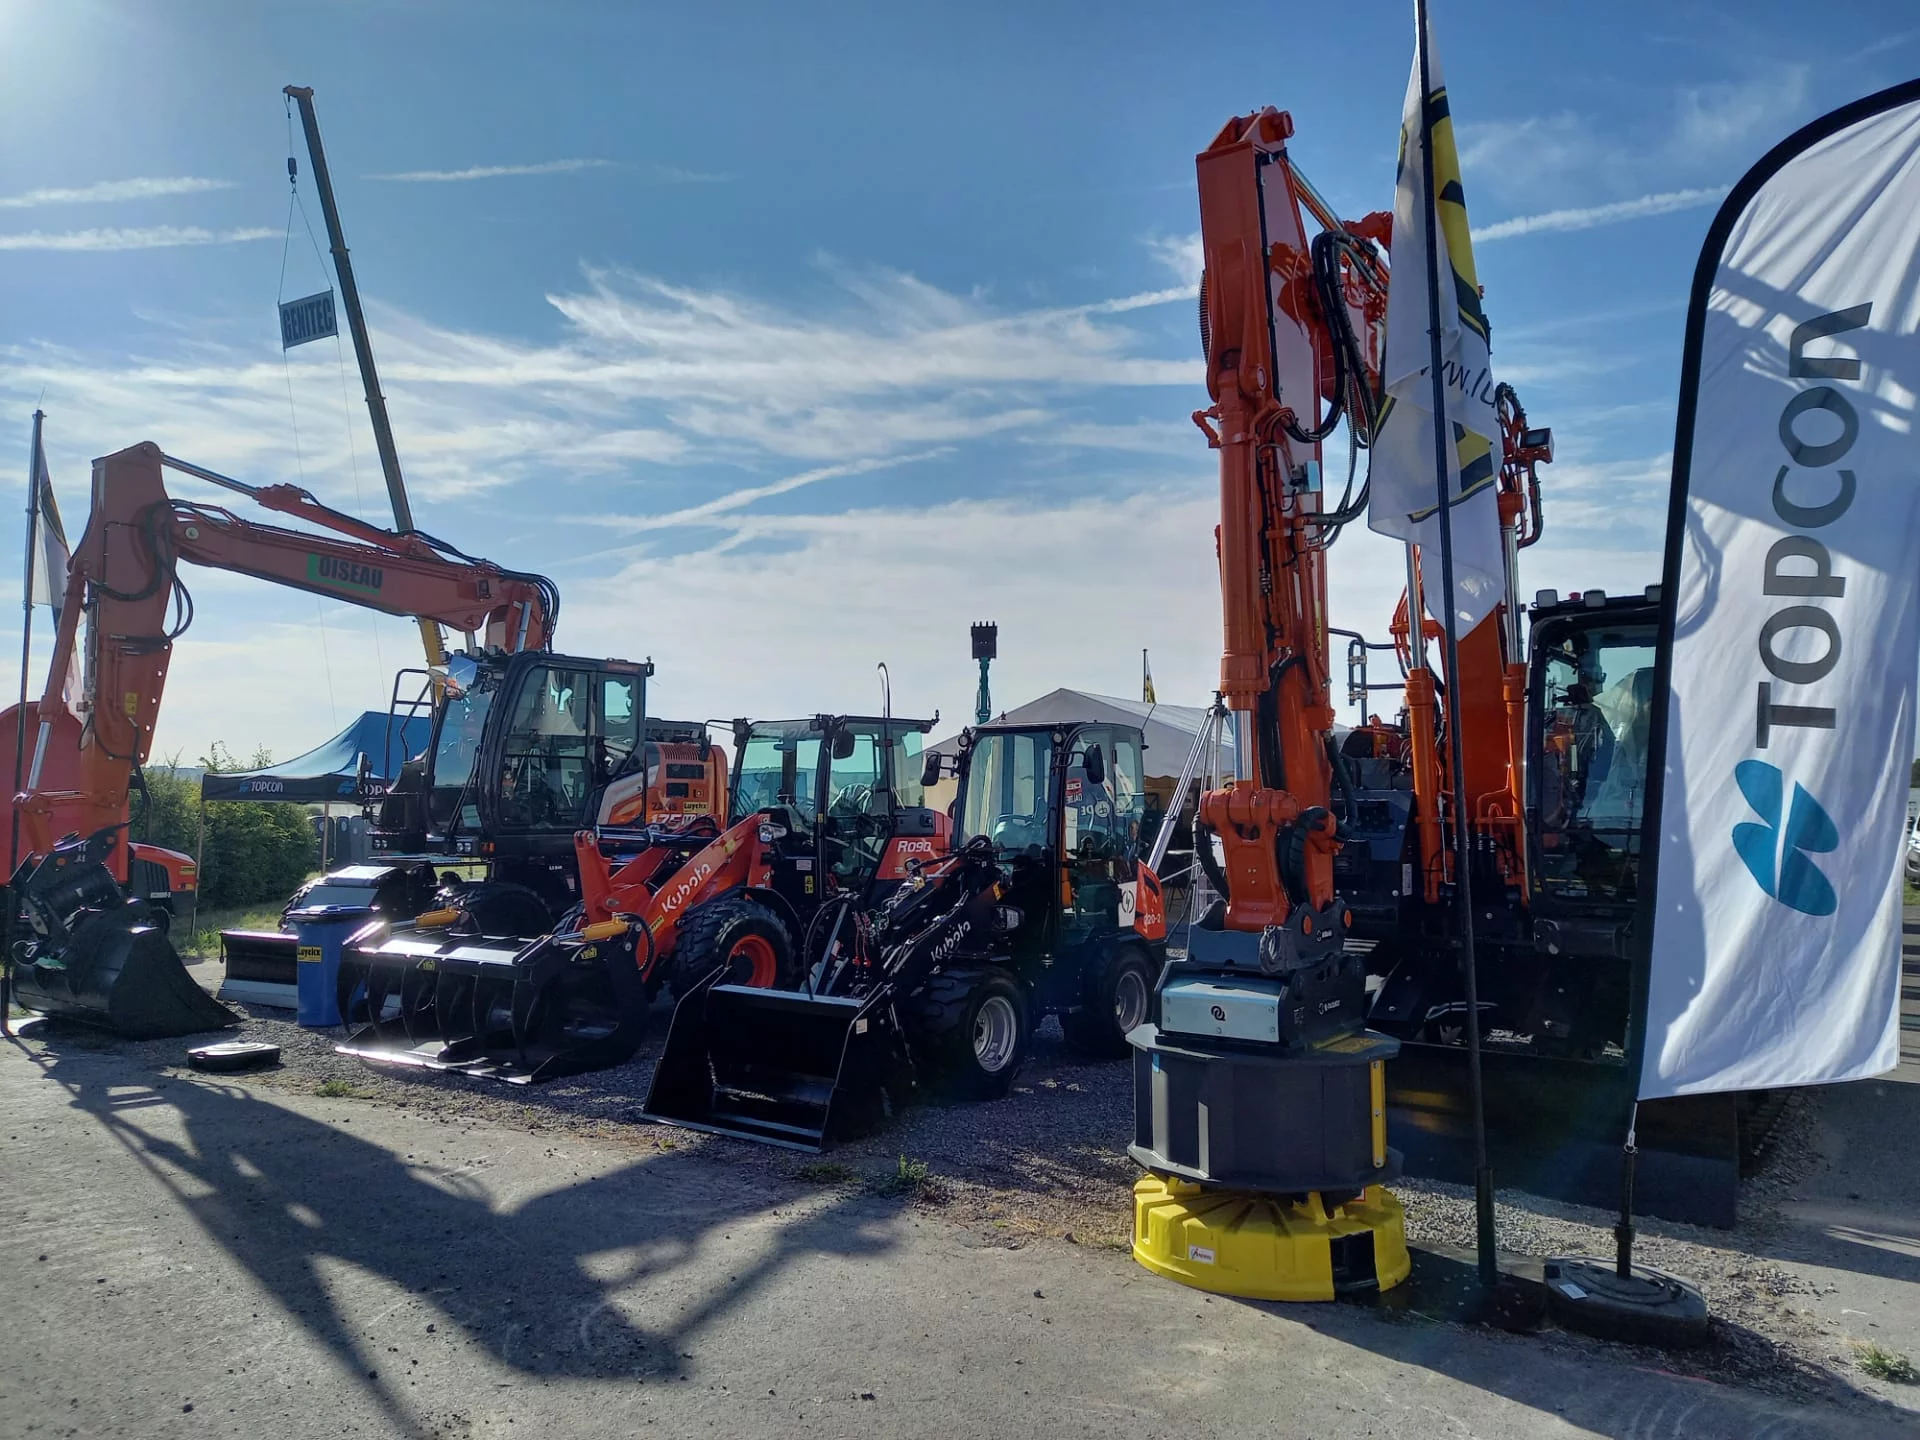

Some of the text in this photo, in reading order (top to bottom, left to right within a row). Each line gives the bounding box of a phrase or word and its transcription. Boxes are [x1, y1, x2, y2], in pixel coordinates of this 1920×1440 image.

[282, 297, 333, 342] GENITEC
[1756, 301, 1874, 750] TOPCON
[319, 555, 383, 589] OISEAU
[250, 780, 284, 793] TOPCON
[897, 840, 932, 853] R090
[660, 863, 712, 913] Kubota
[930, 920, 971, 962] Kubota
